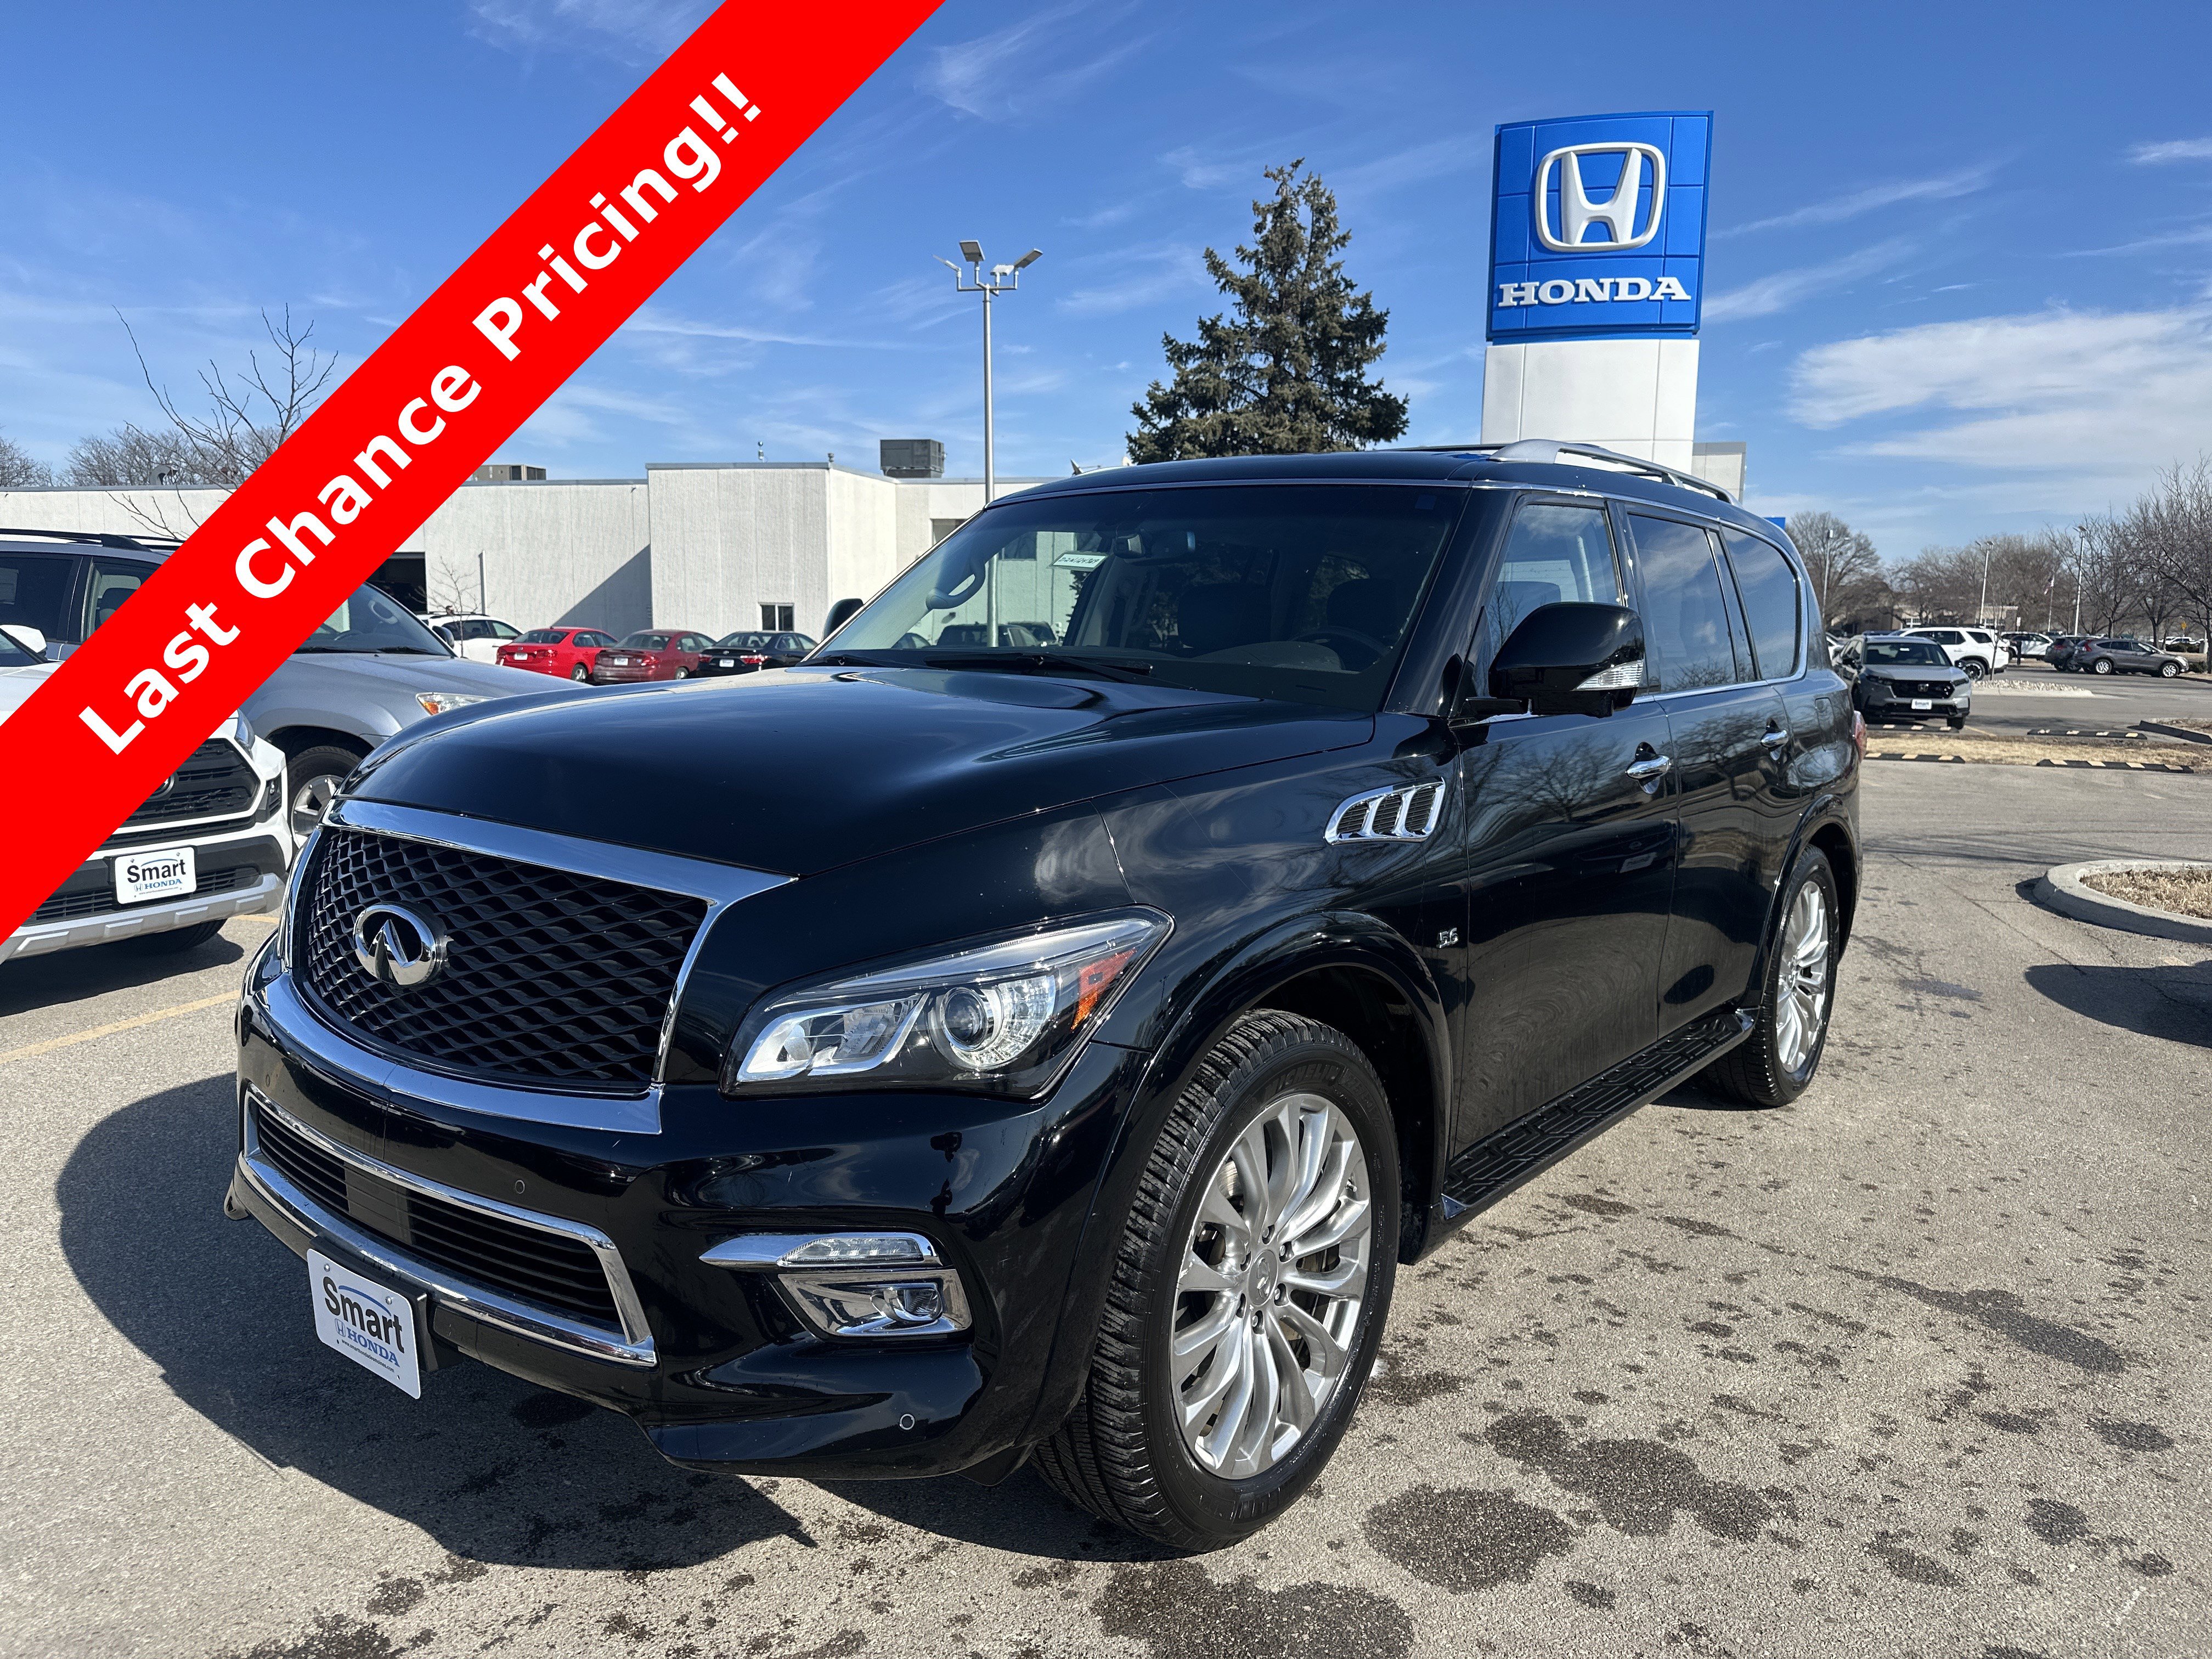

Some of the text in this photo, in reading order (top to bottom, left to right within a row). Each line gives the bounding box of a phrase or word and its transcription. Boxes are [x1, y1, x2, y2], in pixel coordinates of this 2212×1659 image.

[1498, 276, 1692, 307] HONDA
[127, 859, 186, 883] Smart
[144, 879, 183, 889] HONDA
[1264, 1064, 1340, 1099] MICHELIN
[323, 1276, 404, 1353] Smart
[347, 1328, 399, 1367] HONDA
